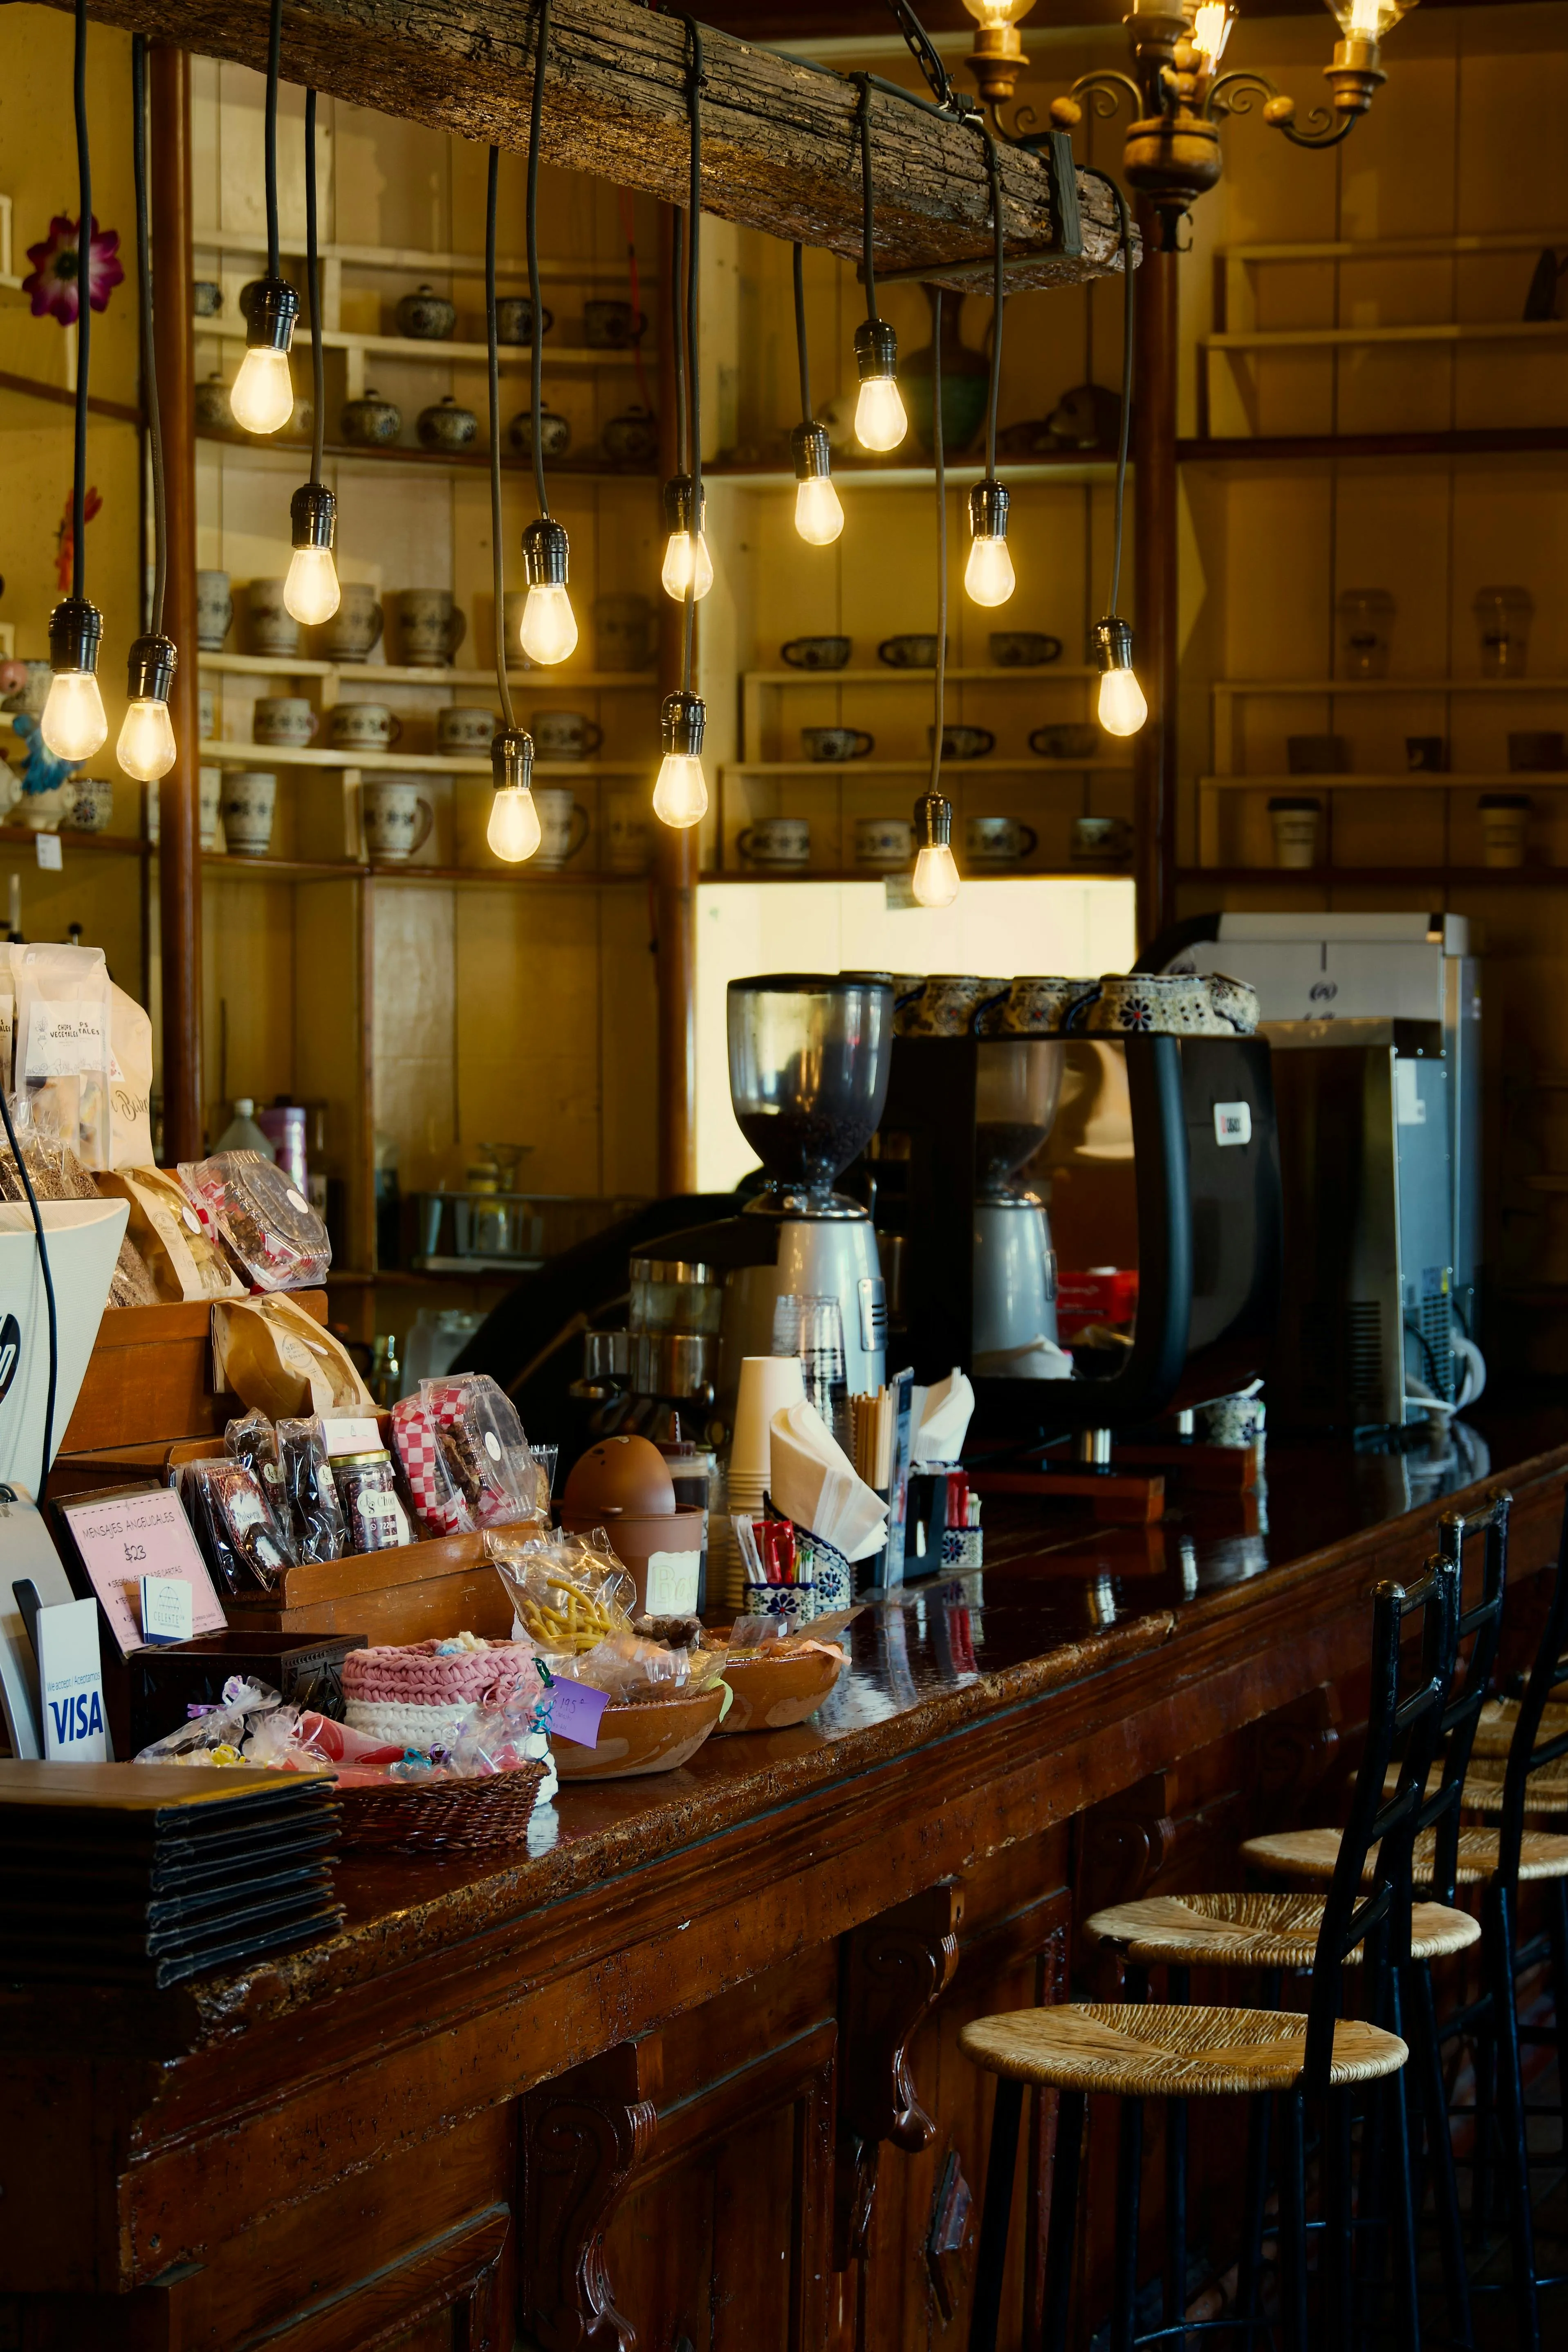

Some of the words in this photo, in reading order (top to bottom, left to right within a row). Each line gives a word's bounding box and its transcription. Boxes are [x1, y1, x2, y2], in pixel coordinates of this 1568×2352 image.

[83, 1522, 123, 1538] MENSAJES
[126, 1512, 175, 1531] ANGELICALES
[237, 1511, 260, 1522] Pulsera
[124, 1543, 146, 1563] $23
[162, 1566, 182, 1576] CARTAS
[154, 1611, 179, 1624] CELESTE
[47, 1682, 55, 1692] We
[56, 1679, 72, 1690] accept
[74, 1672, 101, 1685] Aceptamos
[48, 1691, 103, 1744] VISA
